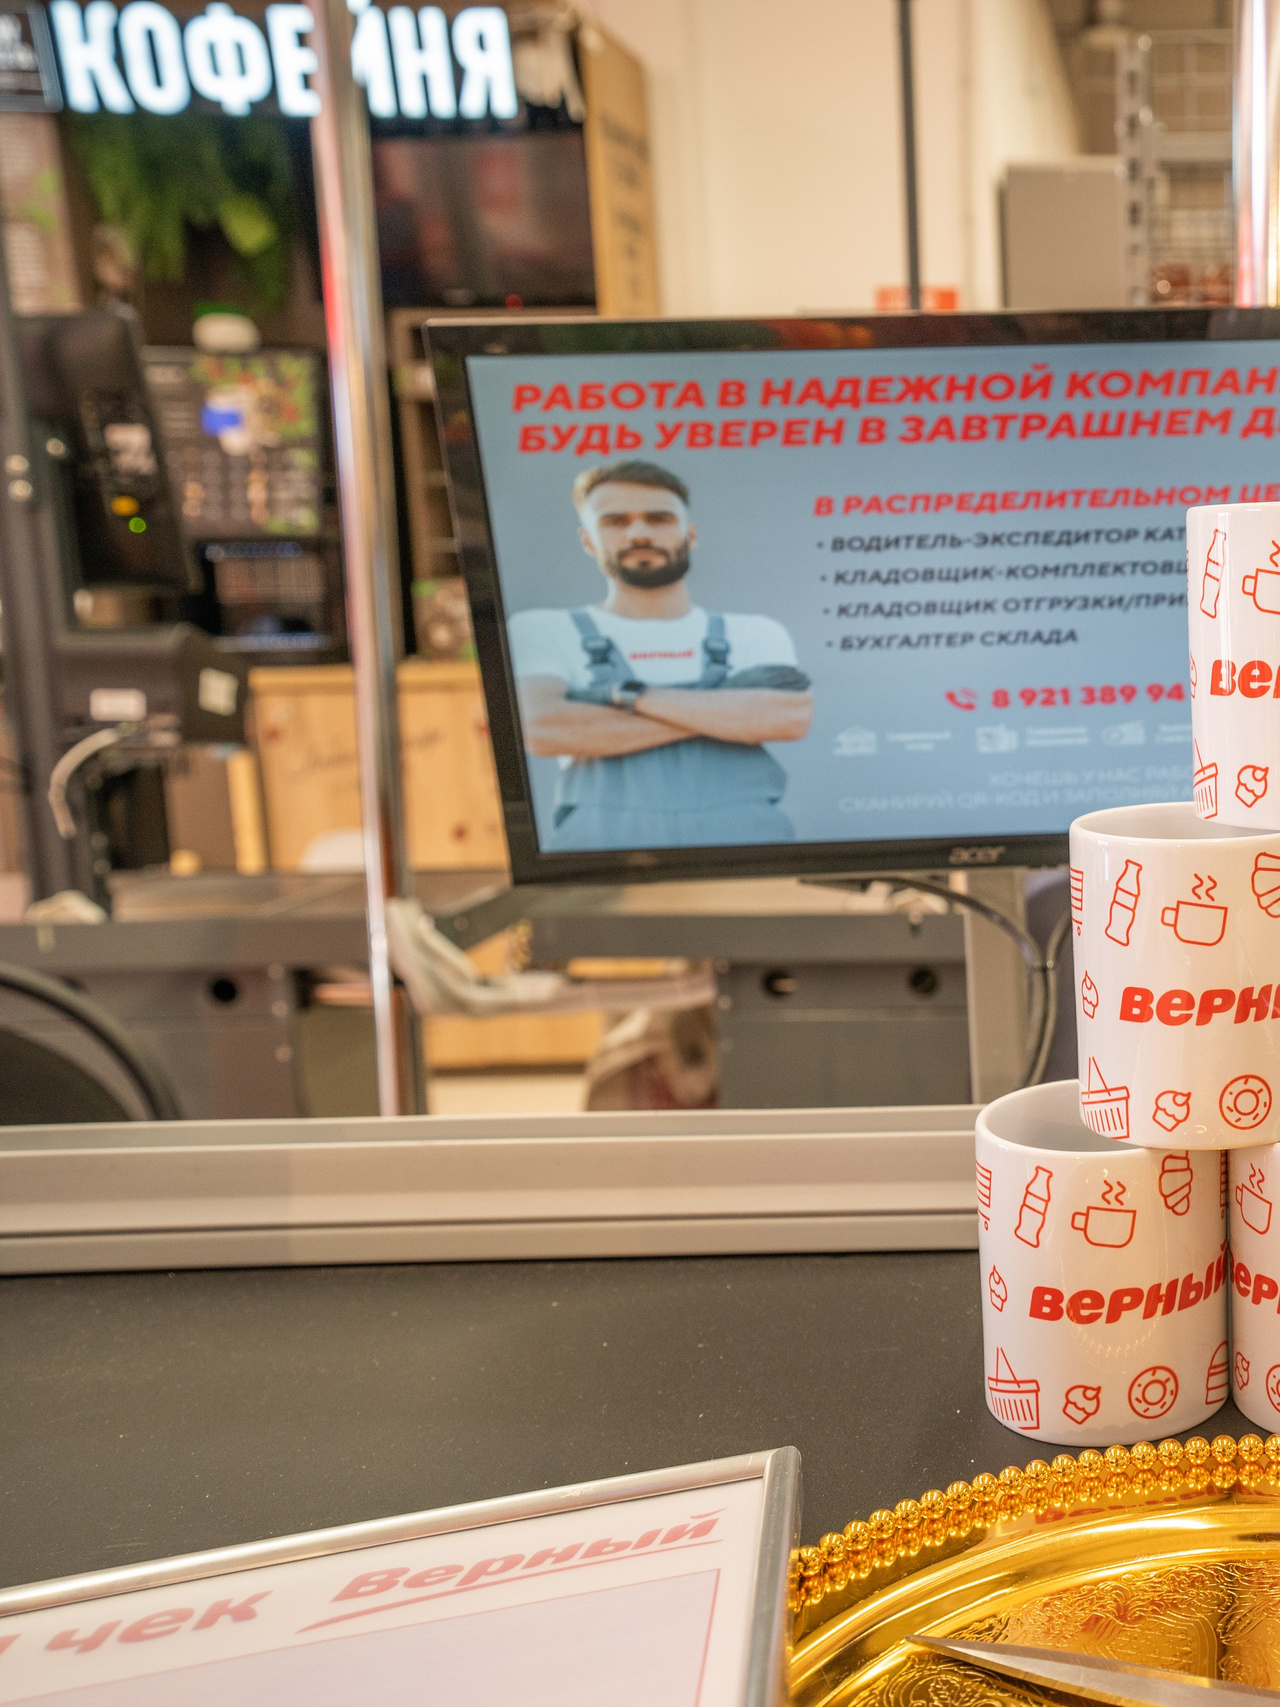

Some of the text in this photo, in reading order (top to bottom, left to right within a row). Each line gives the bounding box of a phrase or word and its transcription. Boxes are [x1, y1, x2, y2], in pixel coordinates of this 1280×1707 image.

[512, 380, 706, 413] РАБОТА
[717, 379, 748, 409] В
[760, 363, 1054, 411] НАДЕЖНОЙ
[518, 422, 643, 456] БУДЬ
[654, 418, 846, 450] УВЕРЕН
[857, 416, 888, 446] В
[898, 406, 1234, 444] ЗАВТРАШНЕМ
[813, 495, 835, 517] В
[842, 484, 1232, 516] РАСПРЕДЕЛИТЕЛЬНОМ
[831, 526, 1140, 553] ВОДИТЕЛЬ-ЭКСПЕДИТОР
[837, 591, 1187, 619] КЛАДОВЩИК ОТГРУЗКИ/ПРИ
[840, 628, 1078, 651] БУХГАЛТЕР СКЛАДА
[991, 682, 1186, 709] 8 921 389 94
[44, 1507, 729, 1654] чек Верный
